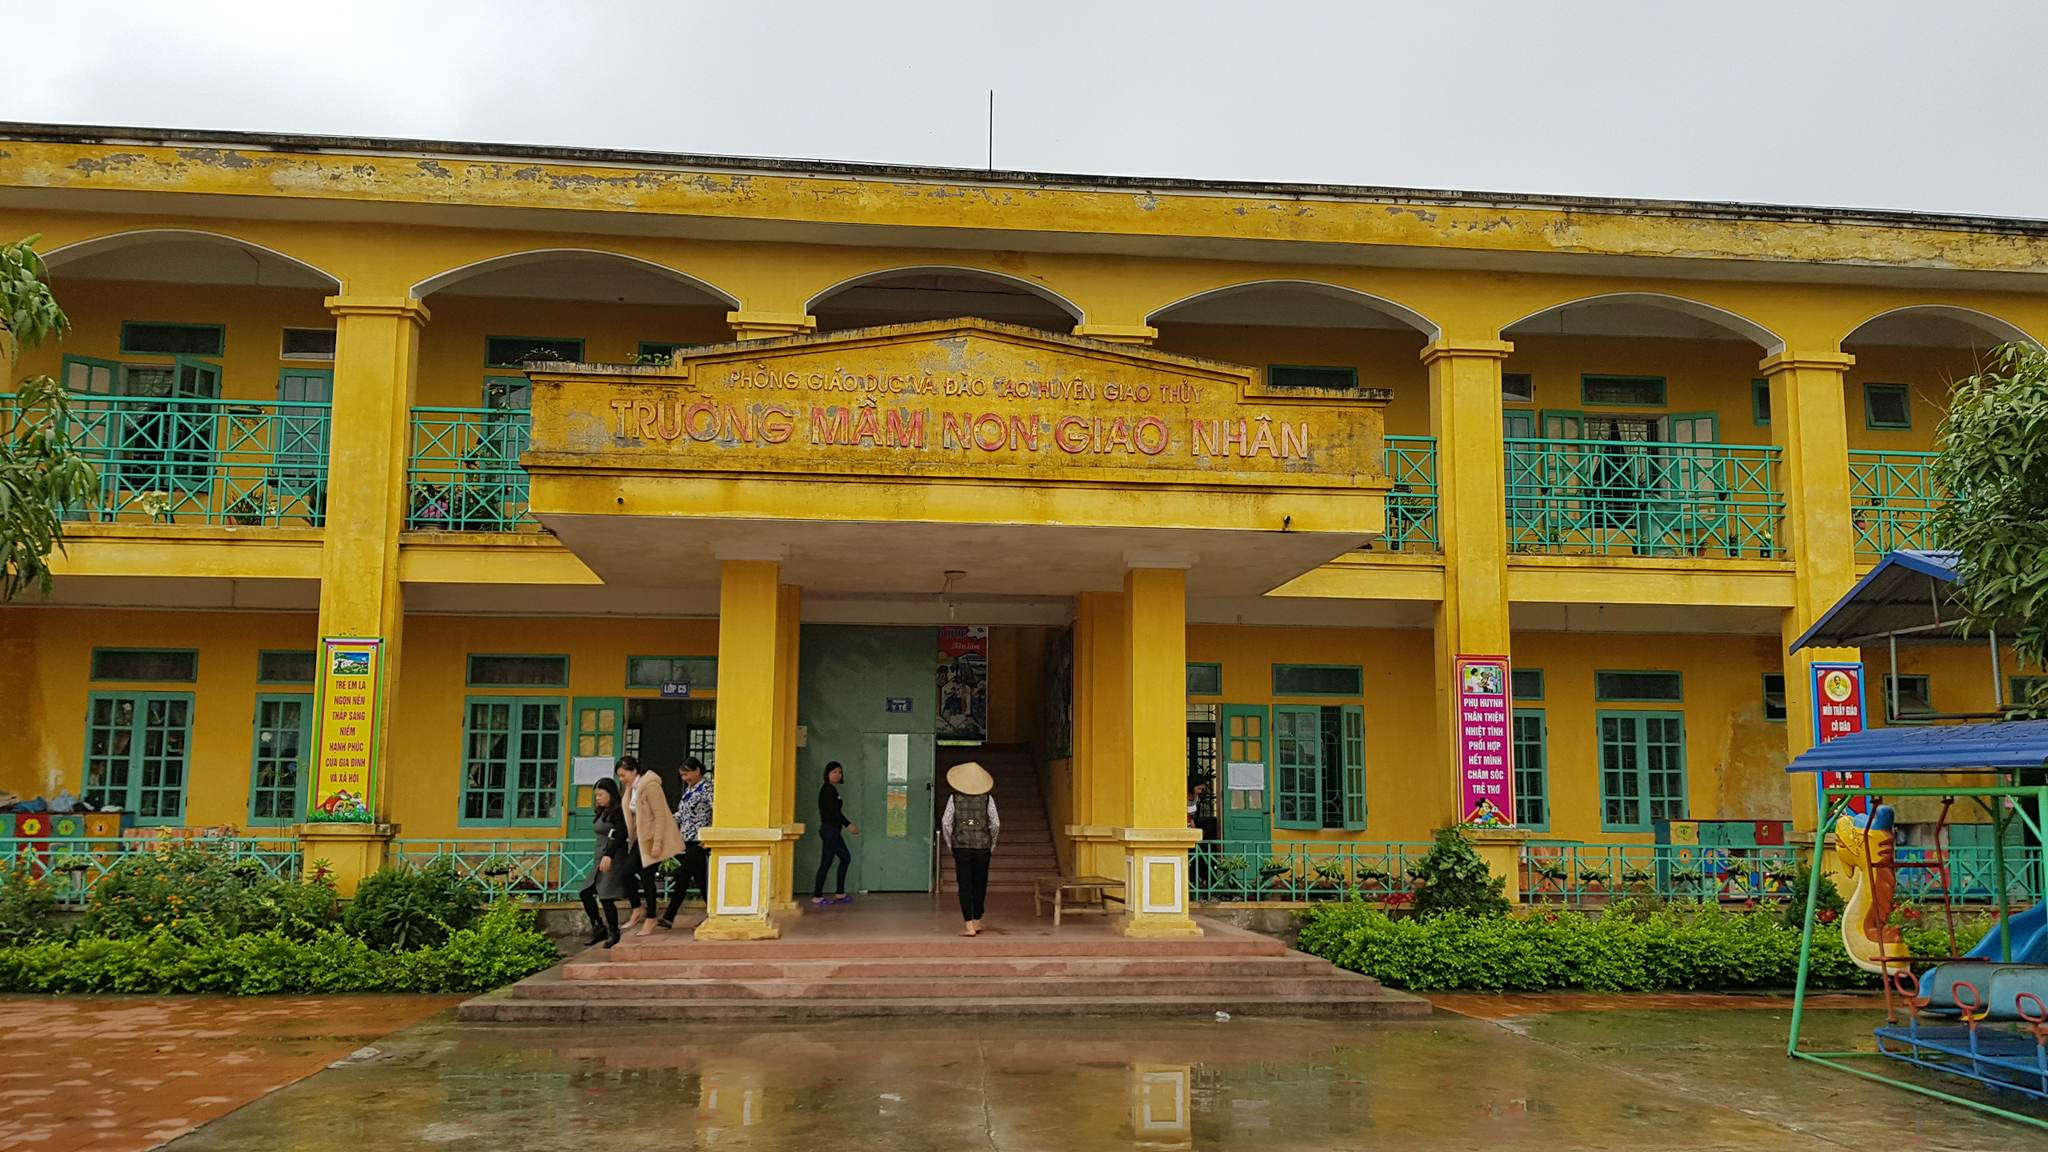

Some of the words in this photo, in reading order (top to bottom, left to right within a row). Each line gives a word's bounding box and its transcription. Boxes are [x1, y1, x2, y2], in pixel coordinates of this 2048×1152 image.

[729, 364, 800, 390] PHÒNG
[807, 367, 858, 392] GIÁO
[865, 374, 904, 397] DỤC
[911, 369, 936, 394] VÀ
[945, 372, 987, 397] ĐÀO
[996, 377, 1031, 401] TẠO
[1038, 377, 1096, 405] HUYỆN
[1103, 383, 1152, 402] GIAO
[1160, 379, 1204, 403] THỦY
[610, 393, 794, 443] TRƯỜNG
[811, 395, 925, 449] MẦM
[942, 410, 1040, 452] NON
[1055, 414, 1170, 455] GIAO
[1192, 415, 1309, 459] NHÂN
[348, 680, 357, 690] EM
[335, 695, 351, 707] NGỌN
[1464, 698, 1479, 709] PHỤ
[1480, 698, 1504, 708] HUYNH
[1464, 710, 1483, 722] THÂN
[1484, 711, 1504, 724] THIỆN
[1466, 725, 1486, 738] NHIỆT
[1488, 725, 1504, 736] TÌNH
[1469, 738, 1486, 751] PHỐI
[1487, 741, 1502, 752] HỢP
[339, 757, 349, 767] GIA
[1469, 753, 1482, 765] HẾT
[1484, 754, 1502, 765] MÌNH
[1468, 769, 1489, 779] CHĂM
[1490, 768, 1504, 780] SÓC
[1473, 781, 1486, 794] TRẺ
[1488, 784, 1501, 794] THƠ
